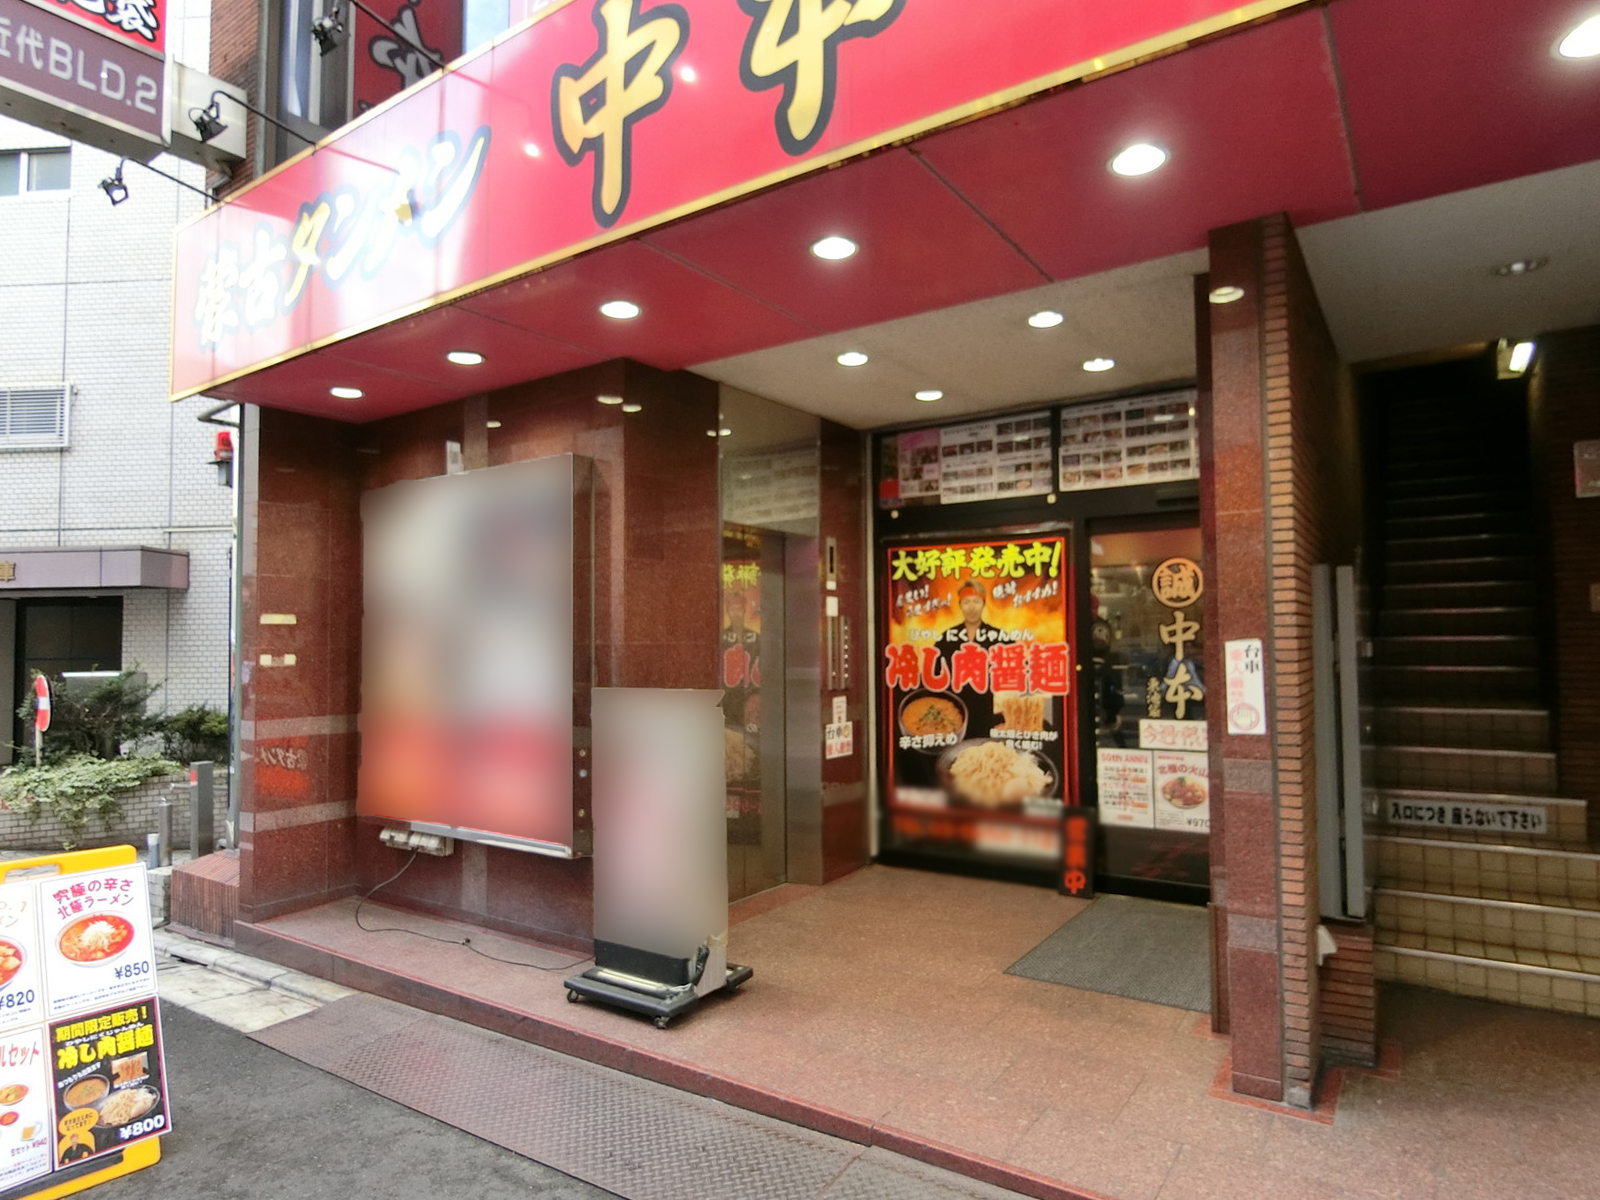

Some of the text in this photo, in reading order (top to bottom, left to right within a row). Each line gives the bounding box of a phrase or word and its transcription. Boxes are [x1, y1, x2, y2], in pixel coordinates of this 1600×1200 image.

[892, 541, 1061, 581] 大好評発売中!
[1158, 610, 1203, 719] 中本
[52, 877, 134, 904] 究極の辛さ
[56, 893, 134, 920] 北極ラーメン
[115, 961, 150, 979] ¥850
[119, 1114, 165, 1140] ¥800
